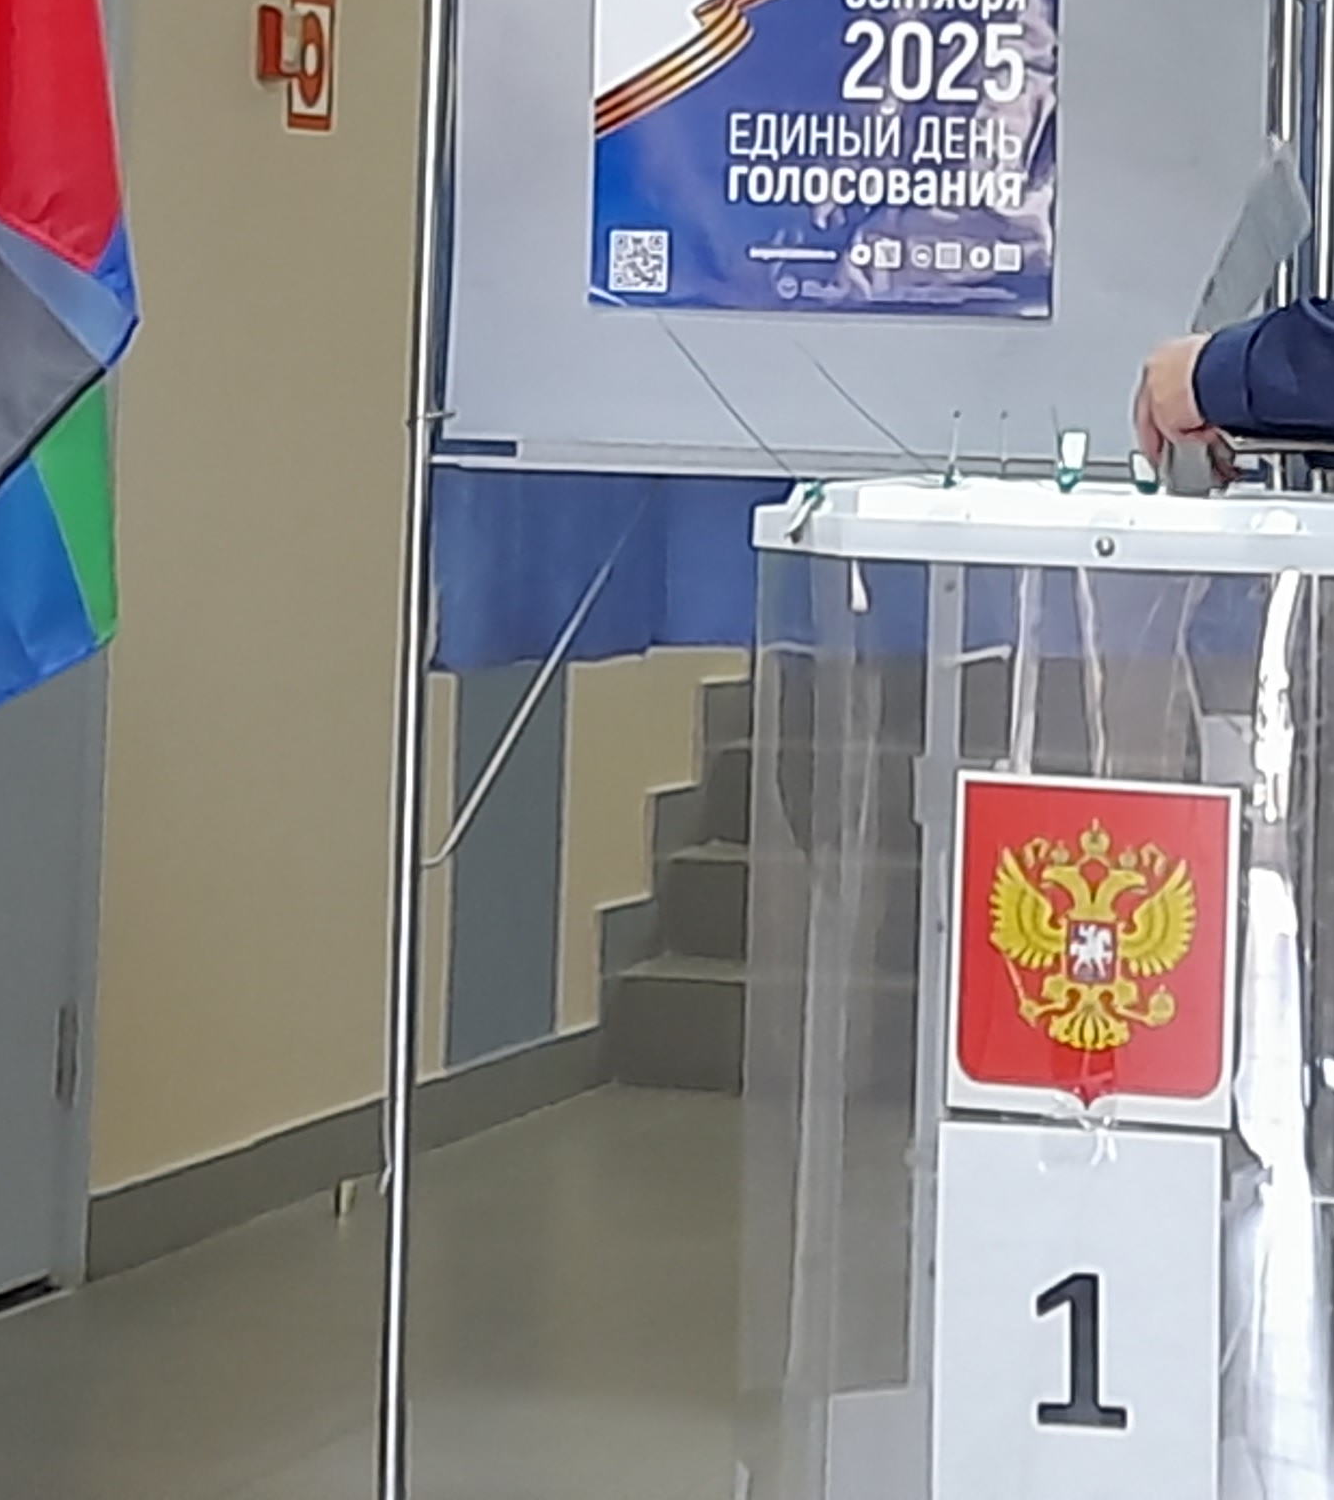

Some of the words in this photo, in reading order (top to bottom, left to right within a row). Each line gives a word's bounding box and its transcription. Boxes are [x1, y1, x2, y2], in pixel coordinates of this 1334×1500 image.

[841, 19, 1025, 103] 2025
[728, 106, 901, 161] ЕДИНЫЙ
[913, 114, 1023, 165] ДЕНЬ
[727, 164, 1023, 209] голосования
[1035, 1271, 1128, 1431] 1
